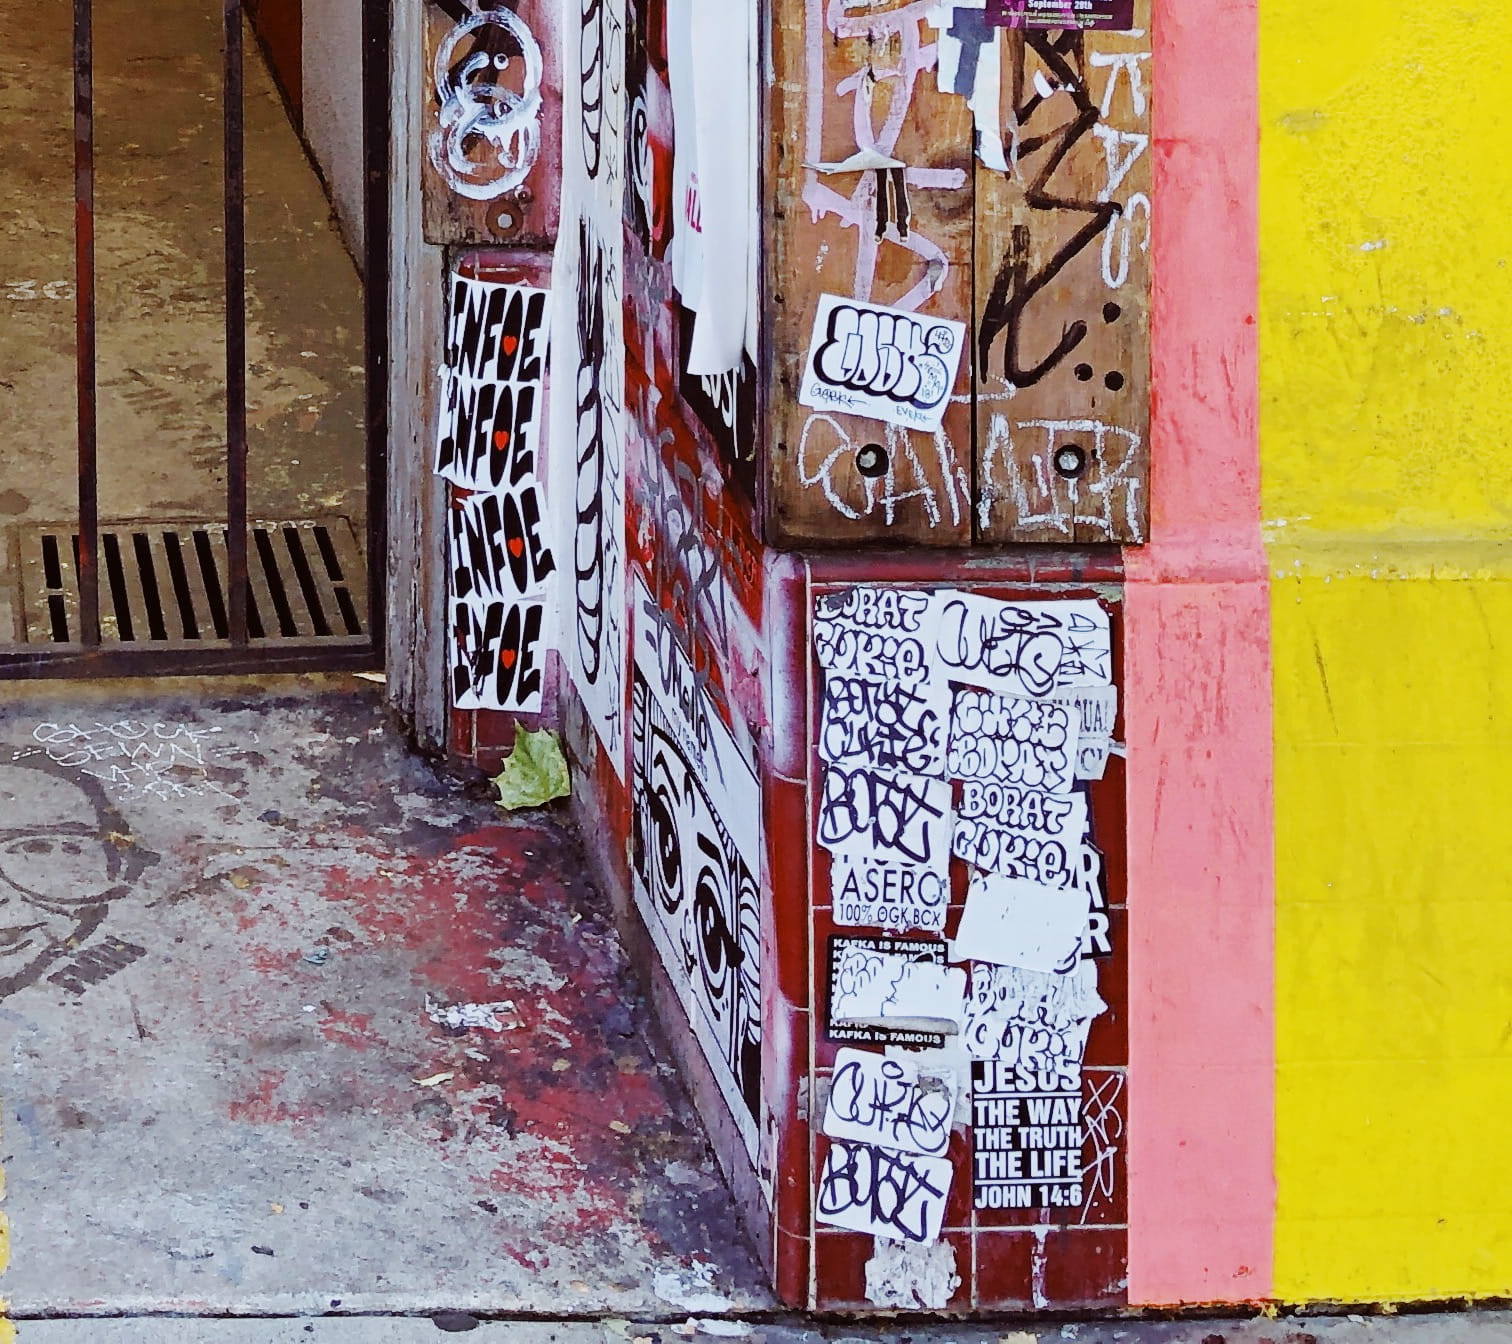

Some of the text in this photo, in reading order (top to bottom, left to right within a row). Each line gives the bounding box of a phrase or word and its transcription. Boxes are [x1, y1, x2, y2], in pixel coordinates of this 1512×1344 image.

[958, 780, 1072, 834] BORAT
[834, 939, 944, 953] KAFKA IS FAMOUS
[974, 1062, 1082, 1093] JESUS
[974, 1098, 1081, 1126] THE WAY
[974, 1127, 1081, 1149] THE TRUTH
[974, 1151, 1081, 1178] THE LIFE
[976, 1185, 1082, 1208] JOHN 14:6
